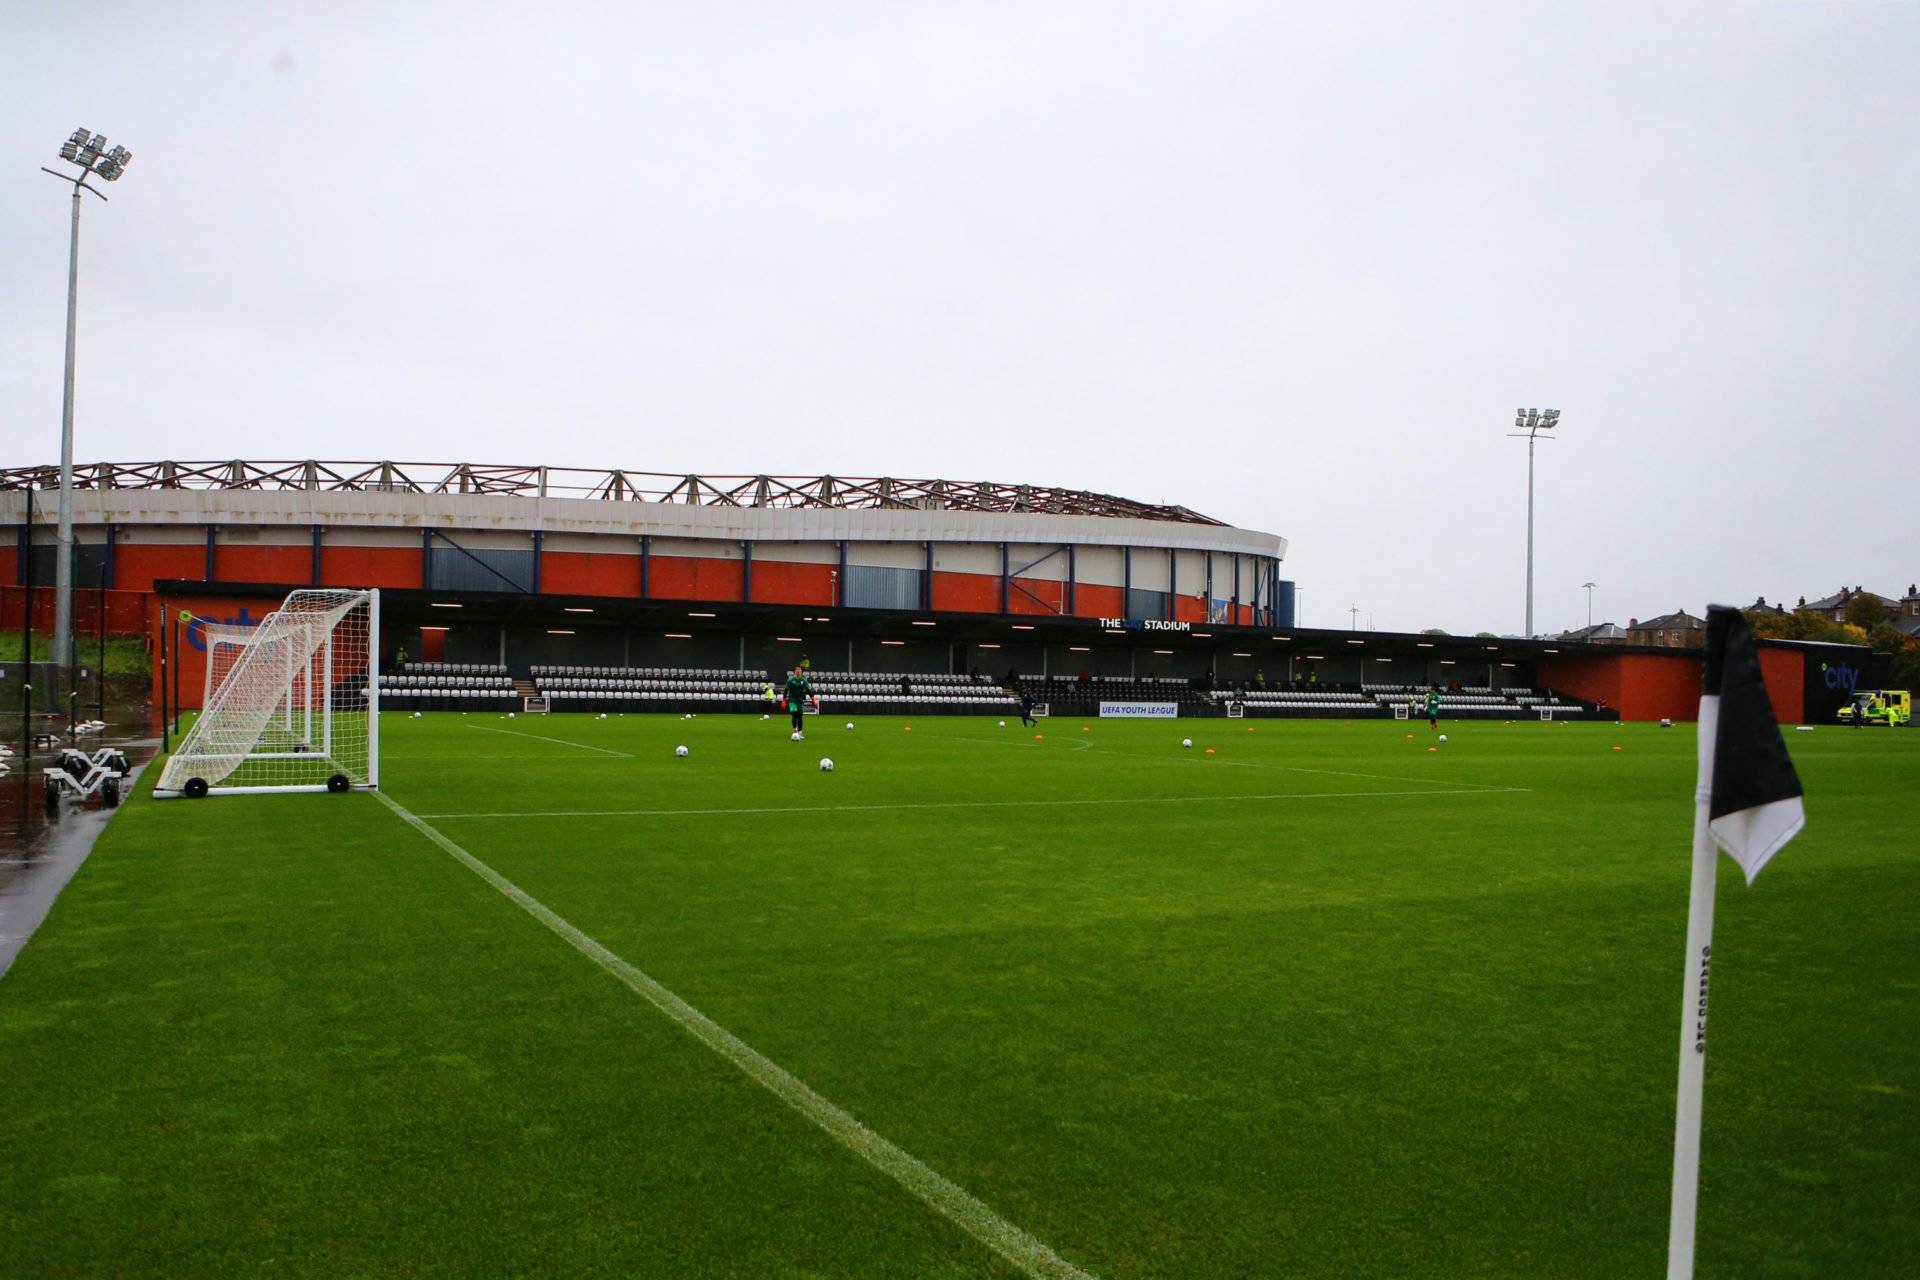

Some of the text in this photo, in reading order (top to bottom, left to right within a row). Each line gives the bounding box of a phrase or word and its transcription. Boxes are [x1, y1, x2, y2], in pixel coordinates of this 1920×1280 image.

[1099, 618, 1121, 628] THE
[1144, 620, 1190, 631] STADIUM
[1824, 662, 1859, 693] city
[1102, 706, 1175, 715] UEFA YOUTH LEAGUE
